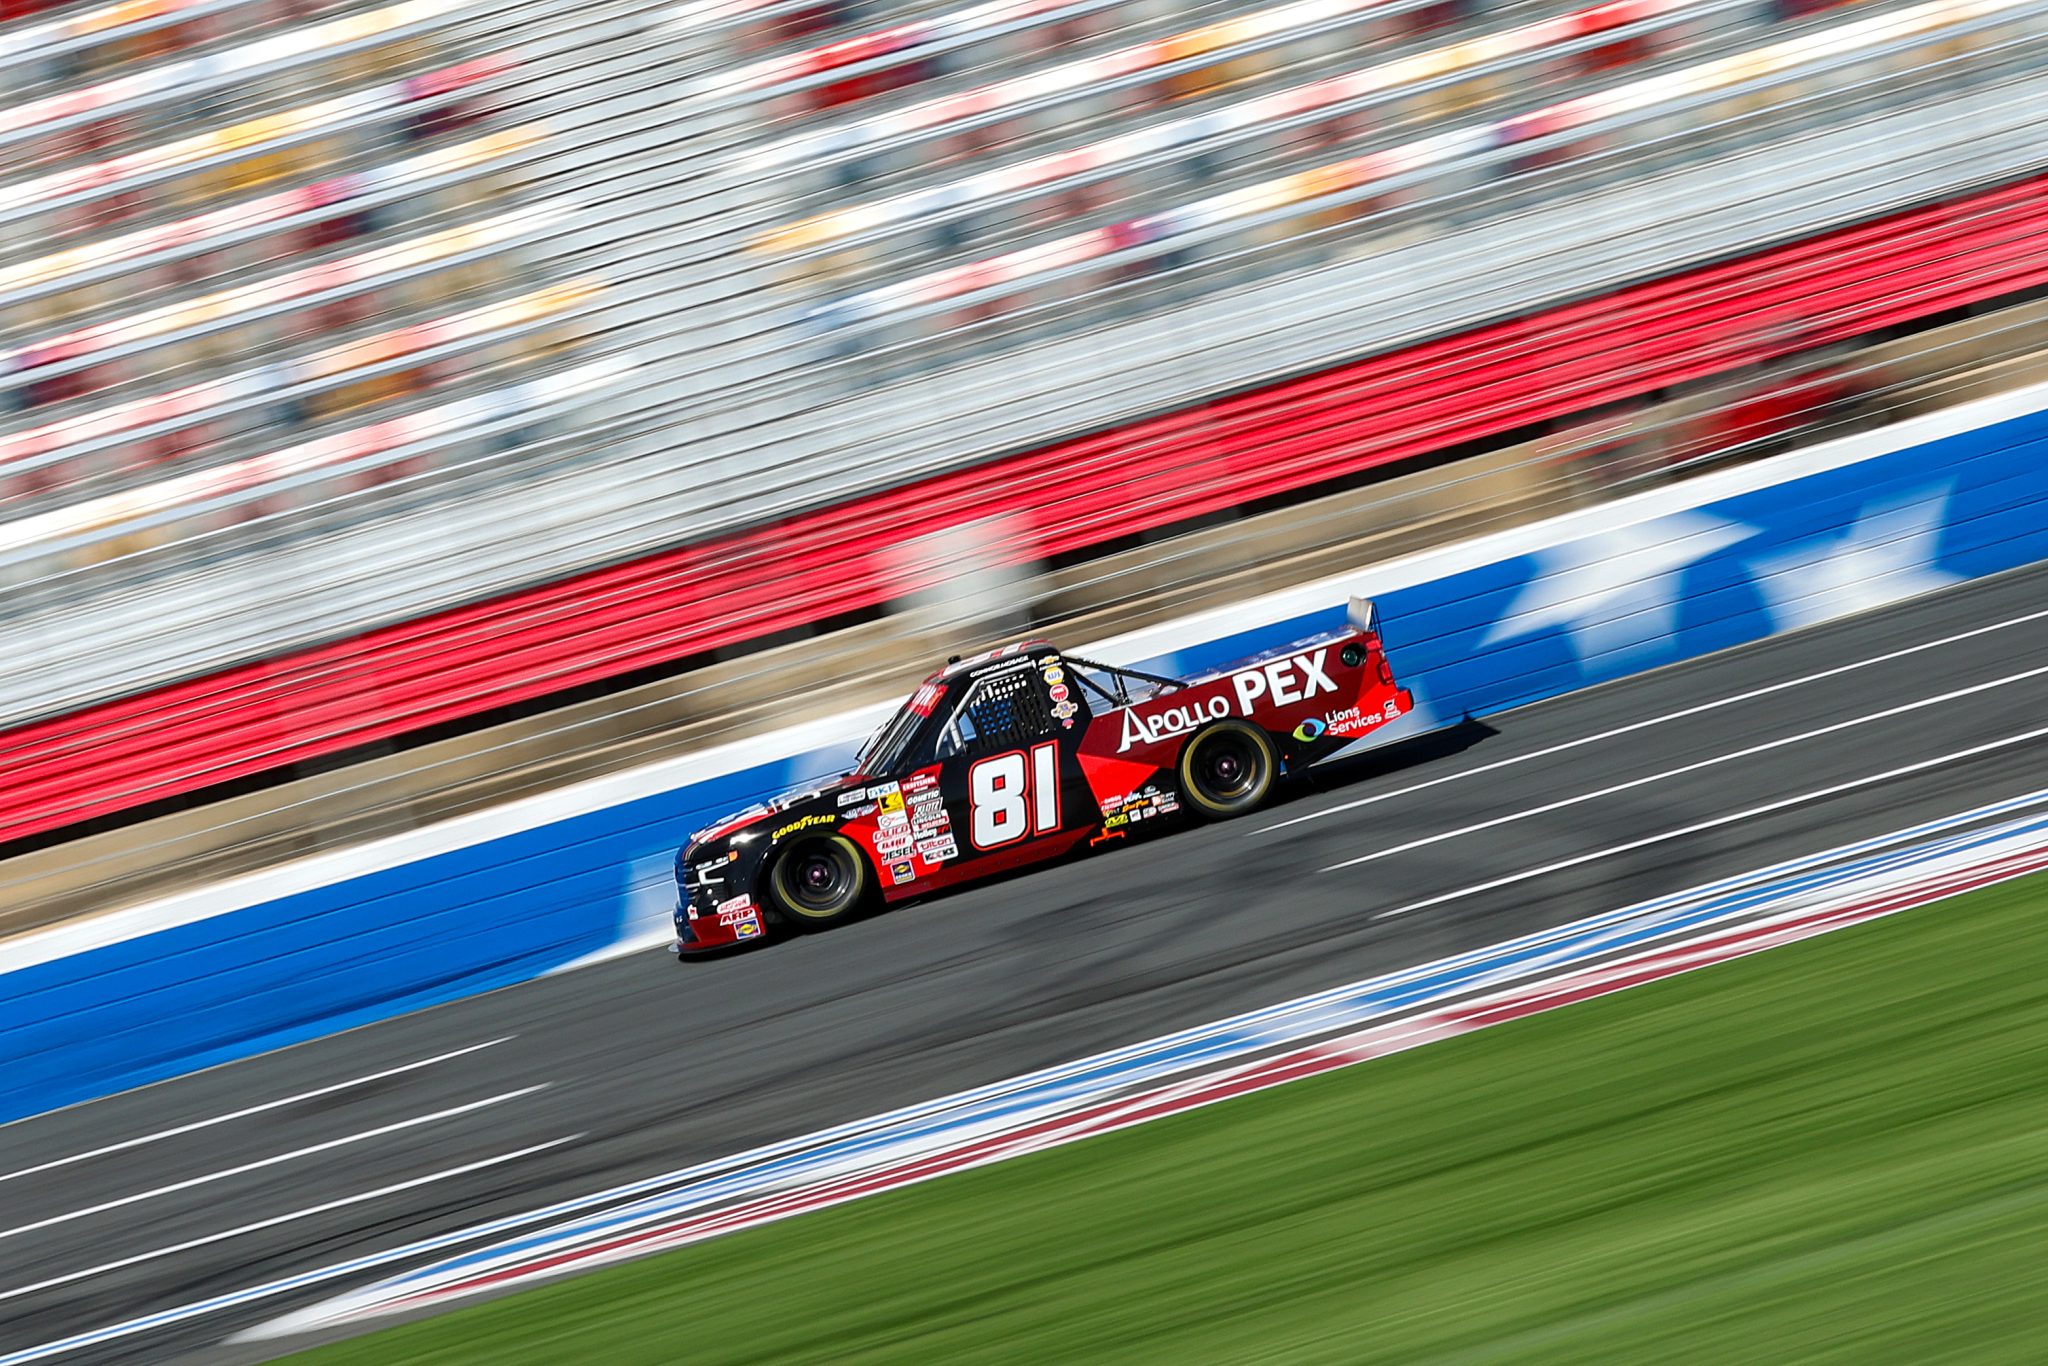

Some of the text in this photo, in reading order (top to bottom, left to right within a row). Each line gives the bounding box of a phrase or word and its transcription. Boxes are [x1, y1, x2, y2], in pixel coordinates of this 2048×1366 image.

[1117, 649, 1338, 753] APOLLO PEX
[1325, 707, 1360, 725] Lions
[1329, 713, 1382, 736] Services
[970, 741, 1060, 850] 81
[771, 814, 836, 840] GOODYEAR
[883, 845, 914, 861] JESEL
[921, 838, 952, 850] tilton
[722, 909, 754, 924] ARP
